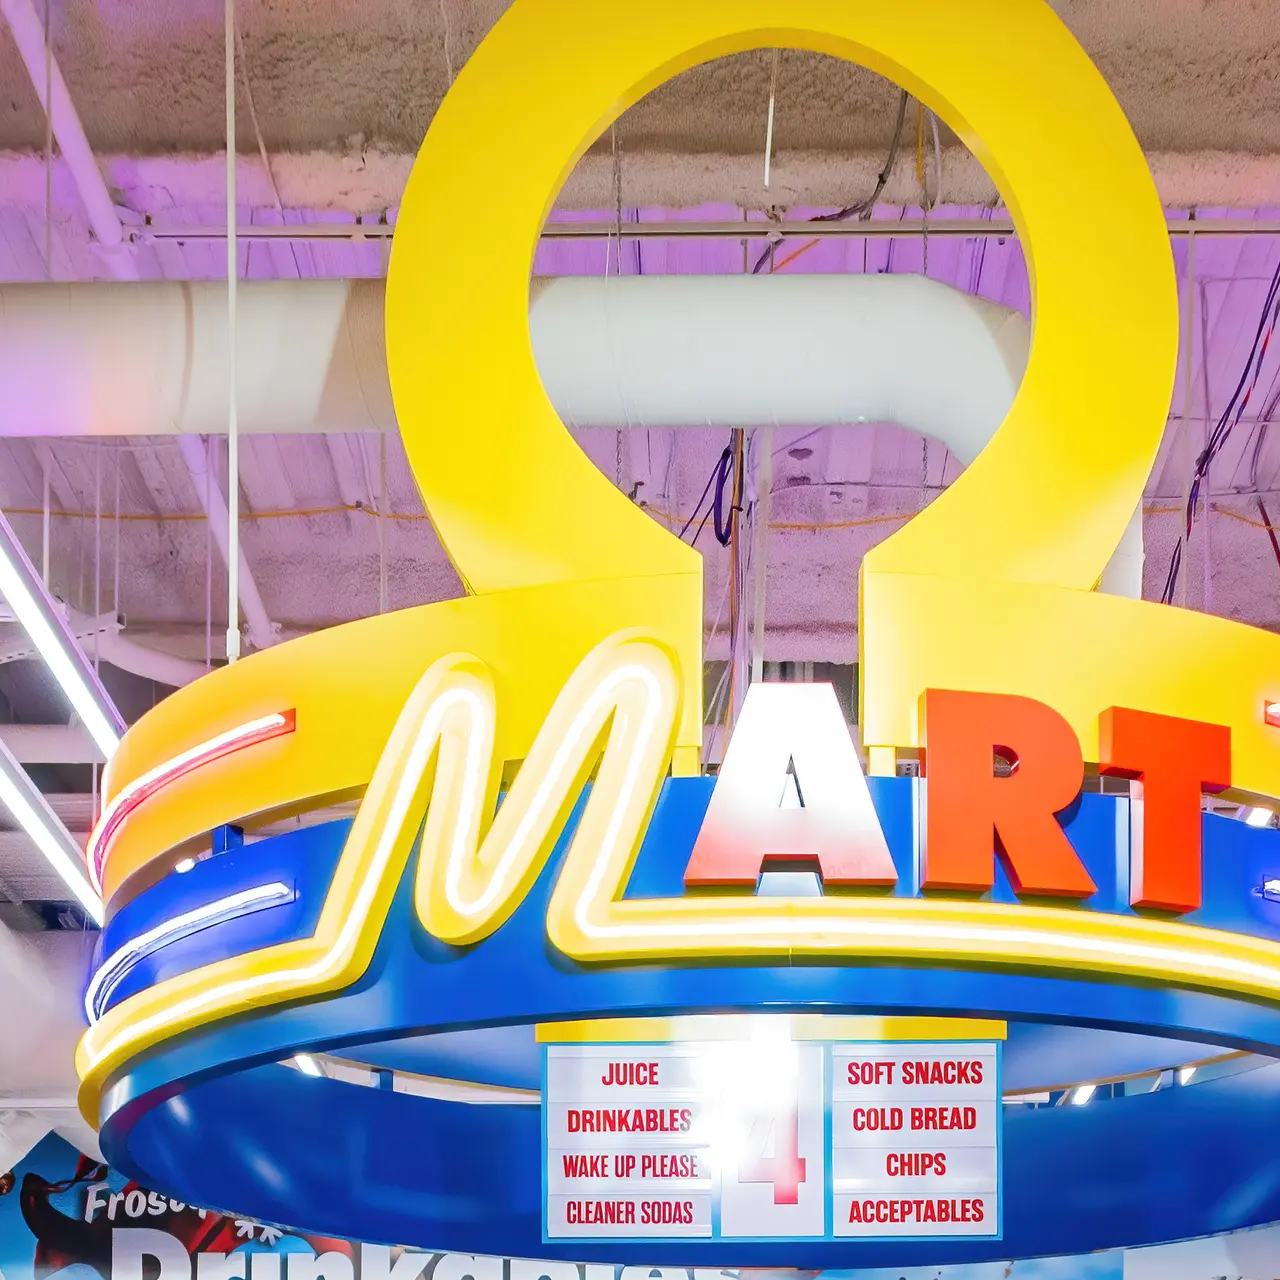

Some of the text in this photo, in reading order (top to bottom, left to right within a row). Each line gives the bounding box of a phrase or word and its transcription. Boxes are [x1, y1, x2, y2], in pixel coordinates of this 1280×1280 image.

[305, 637, 1232, 961] MART
[602, 1062, 659, 1086] JUICE
[847, 1061, 983, 1085] SOFT SNACKS
[567, 1109, 692, 1133] DRINKABLES
[853, 1107, 977, 1131] COLD BREAD
[563, 1155, 698, 1179] WAKE UP PLEASE
[886, 1153, 946, 1177] CHIPS
[566, 1201, 693, 1225] CLEANER SODAS
[848, 1199, 984, 1223] ACCEPTABLES
